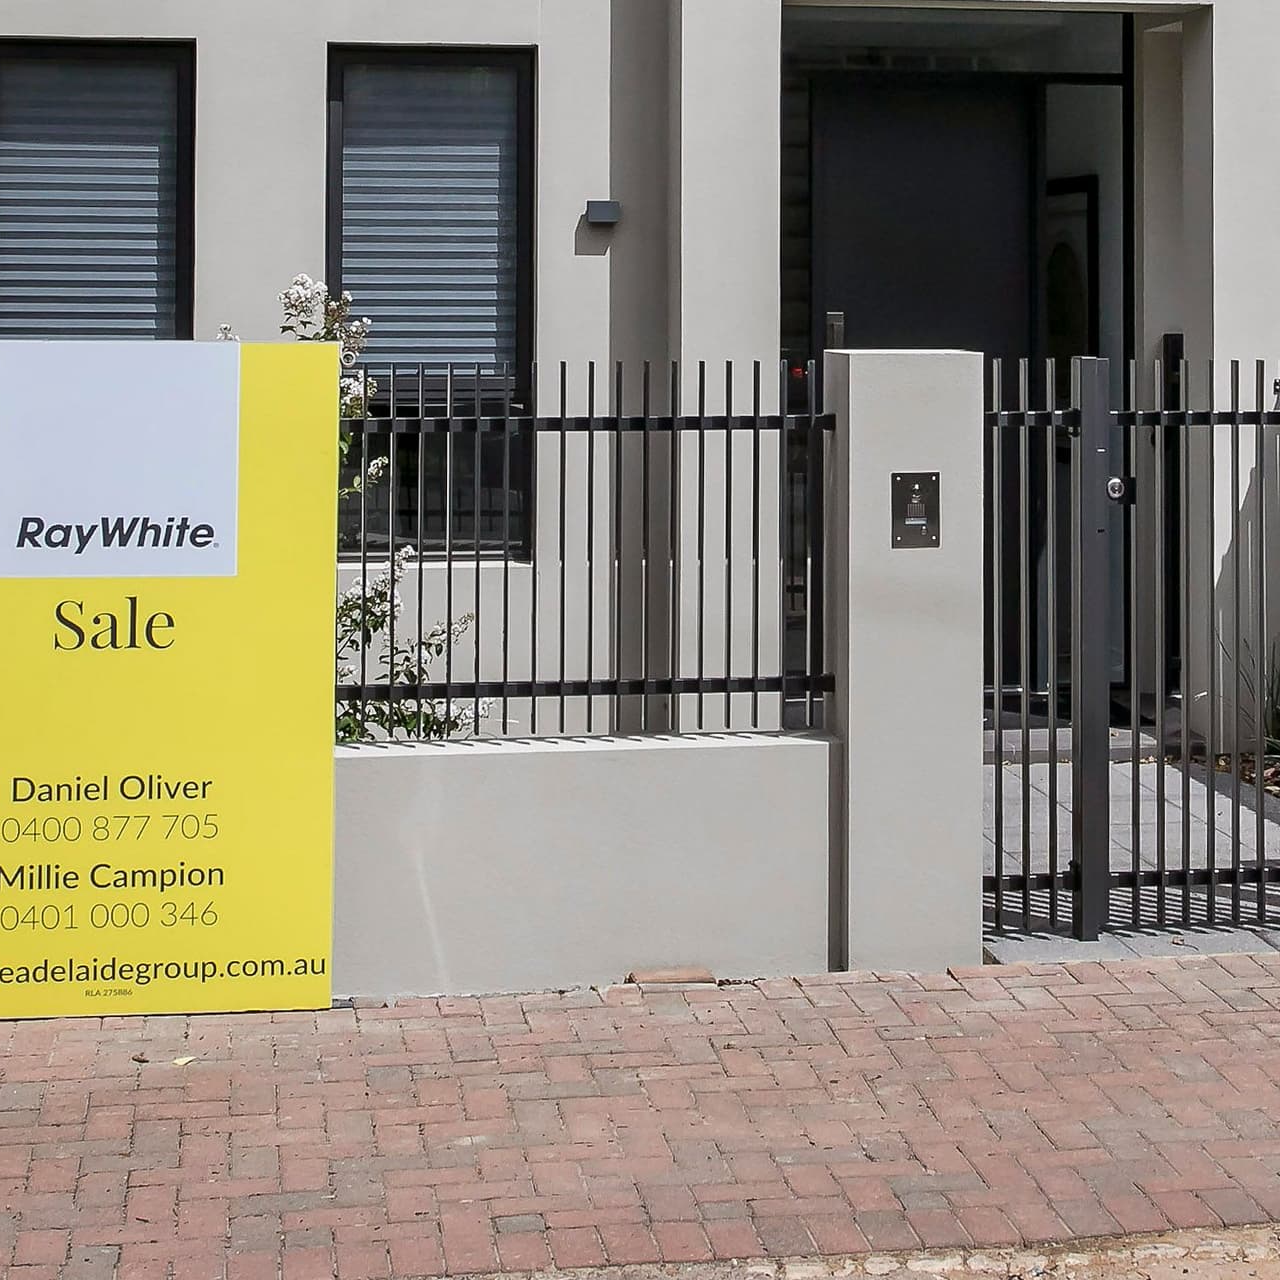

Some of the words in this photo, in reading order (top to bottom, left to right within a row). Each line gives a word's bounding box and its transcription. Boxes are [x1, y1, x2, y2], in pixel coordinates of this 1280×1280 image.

[54, 596, 175, 651] Sale
[12, 775, 109, 803] Daniel
[119, 774, 213, 801] Oliver
[1, 816, 81, 844] 0400
[92, 815, 151, 842] 877
[162, 813, 218, 840] 705
[89, 861, 224, 892] Campion
[0, 904, 78, 931] 0401
[90, 902, 149, 929] 000
[160, 901, 218, 928] 346
[85, 989, 101, 997] RLA
